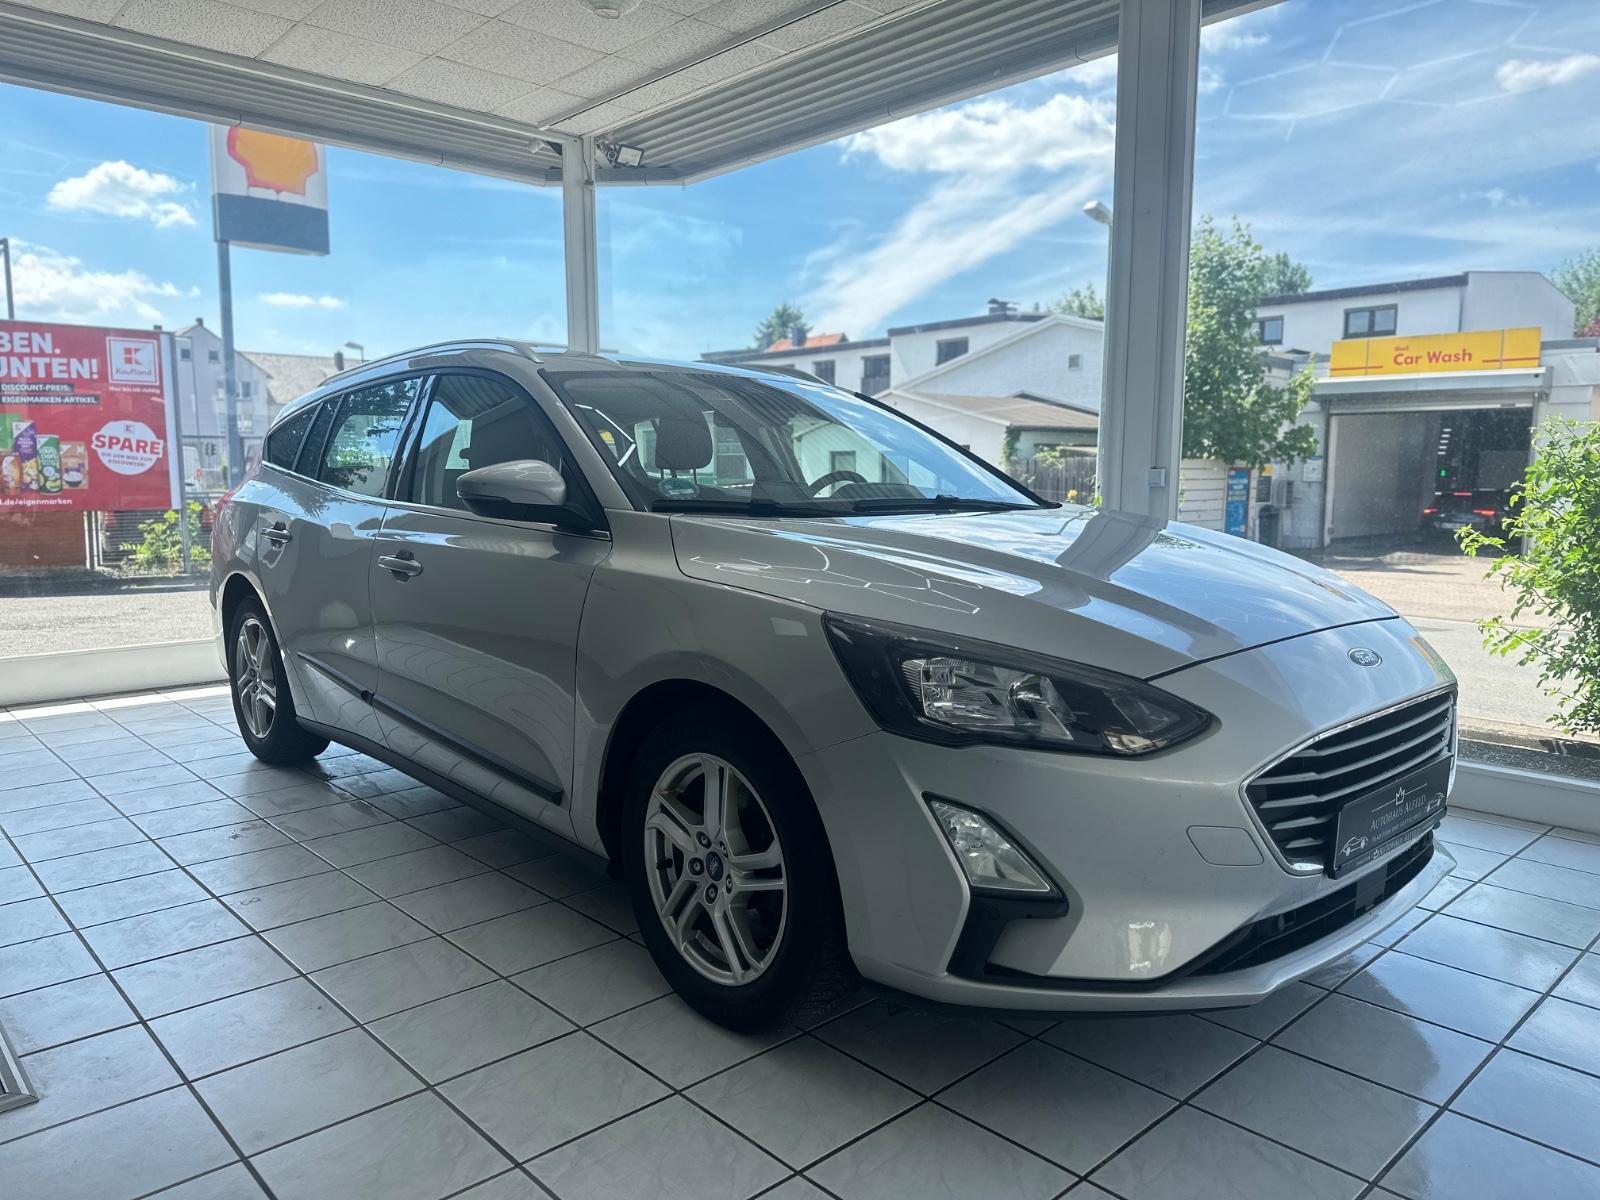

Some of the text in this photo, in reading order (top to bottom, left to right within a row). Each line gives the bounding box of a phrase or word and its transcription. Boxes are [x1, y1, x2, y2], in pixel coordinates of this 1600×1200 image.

[0, 331, 60, 354] BEN.
[1393, 348, 1472, 365] Car Wash
[115, 368, 152, 376] Kaufland
[95, 434, 160, 455] SPARE
[1370, 807, 1403, 832] AUTOHAUS
[1404, 794, 1426, 813] ALFELD
